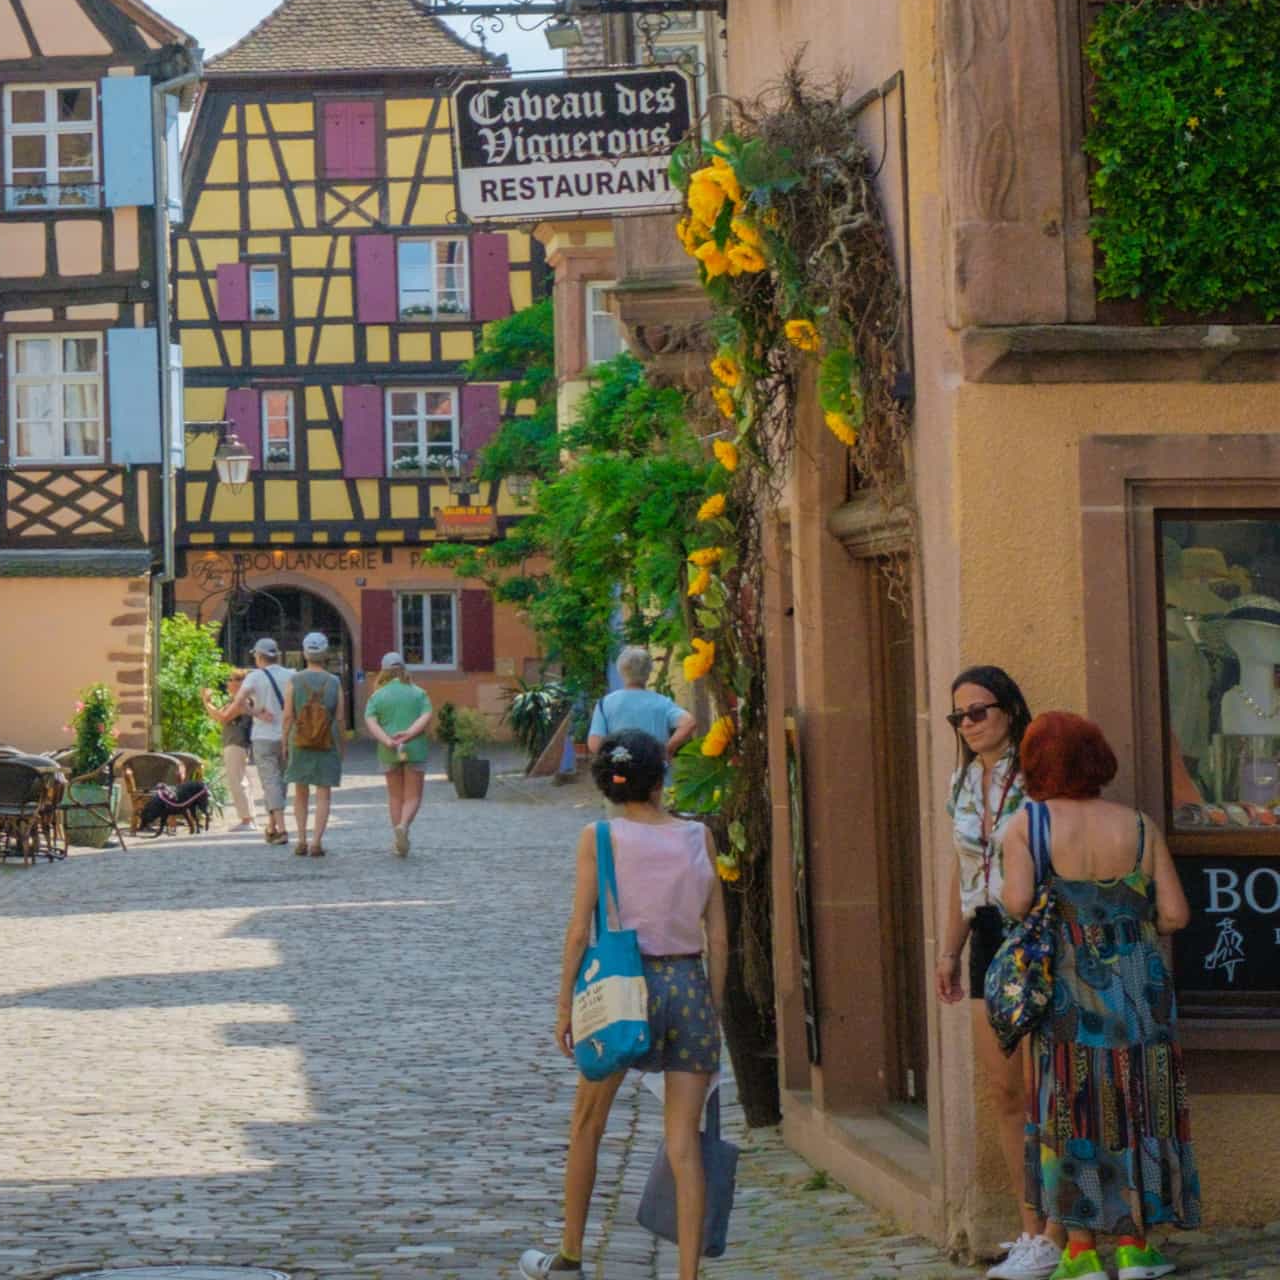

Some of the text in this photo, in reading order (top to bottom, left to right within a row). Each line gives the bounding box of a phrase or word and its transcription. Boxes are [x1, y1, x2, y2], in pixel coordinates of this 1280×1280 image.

[469, 82, 676, 125] Caveau des
[478, 122, 672, 164] Vignerons
[480, 168, 671, 203] RESTAURANT
[243, 552, 377, 570] BOULANGERIE
